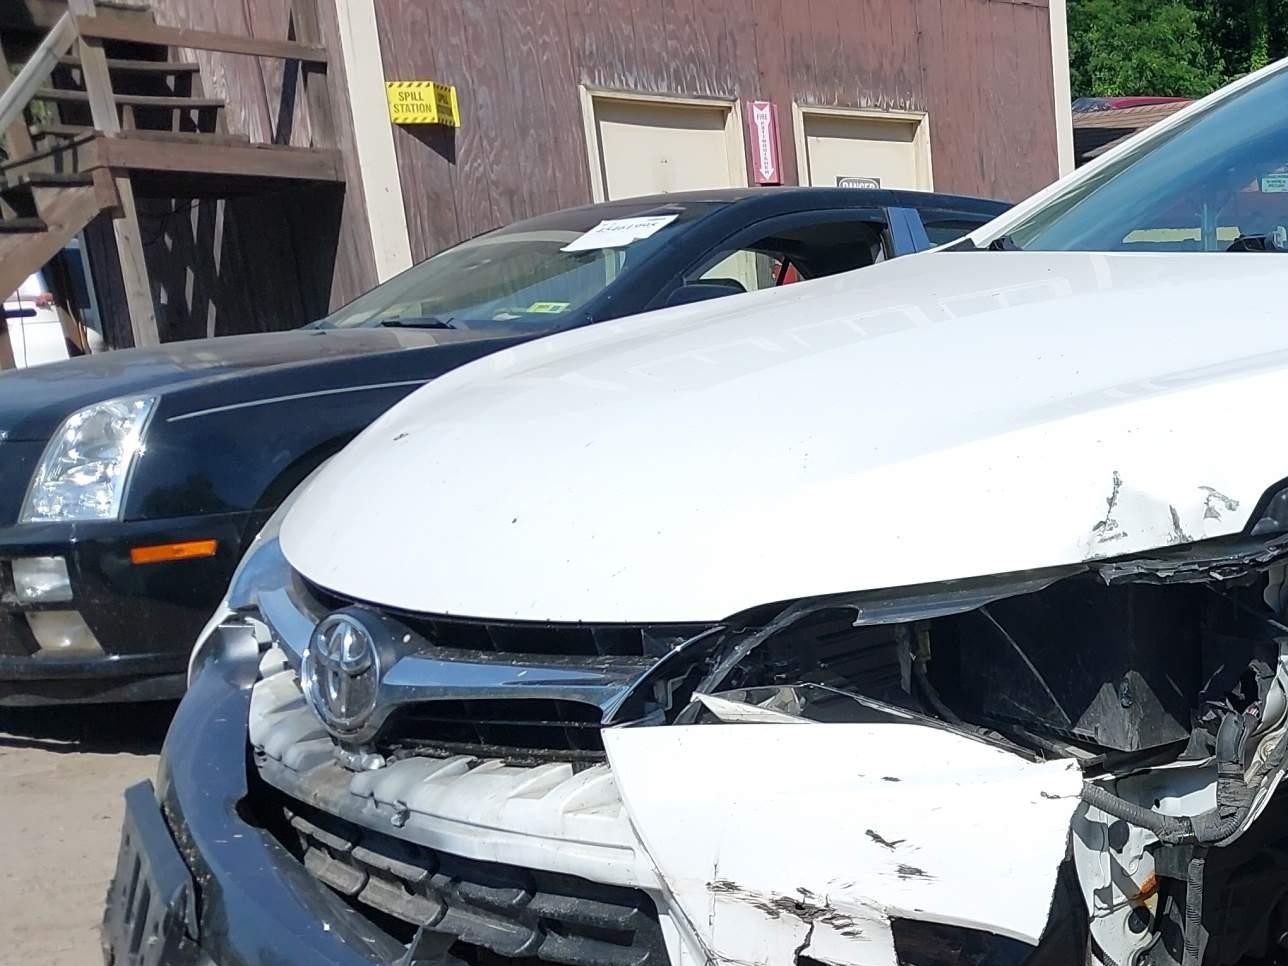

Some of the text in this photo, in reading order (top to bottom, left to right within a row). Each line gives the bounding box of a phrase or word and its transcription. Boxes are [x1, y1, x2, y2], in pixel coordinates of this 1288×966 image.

[398, 91, 424, 102] SPILL
[393, 103, 432, 114] STATION
[711, 209, 729, 219] 03
